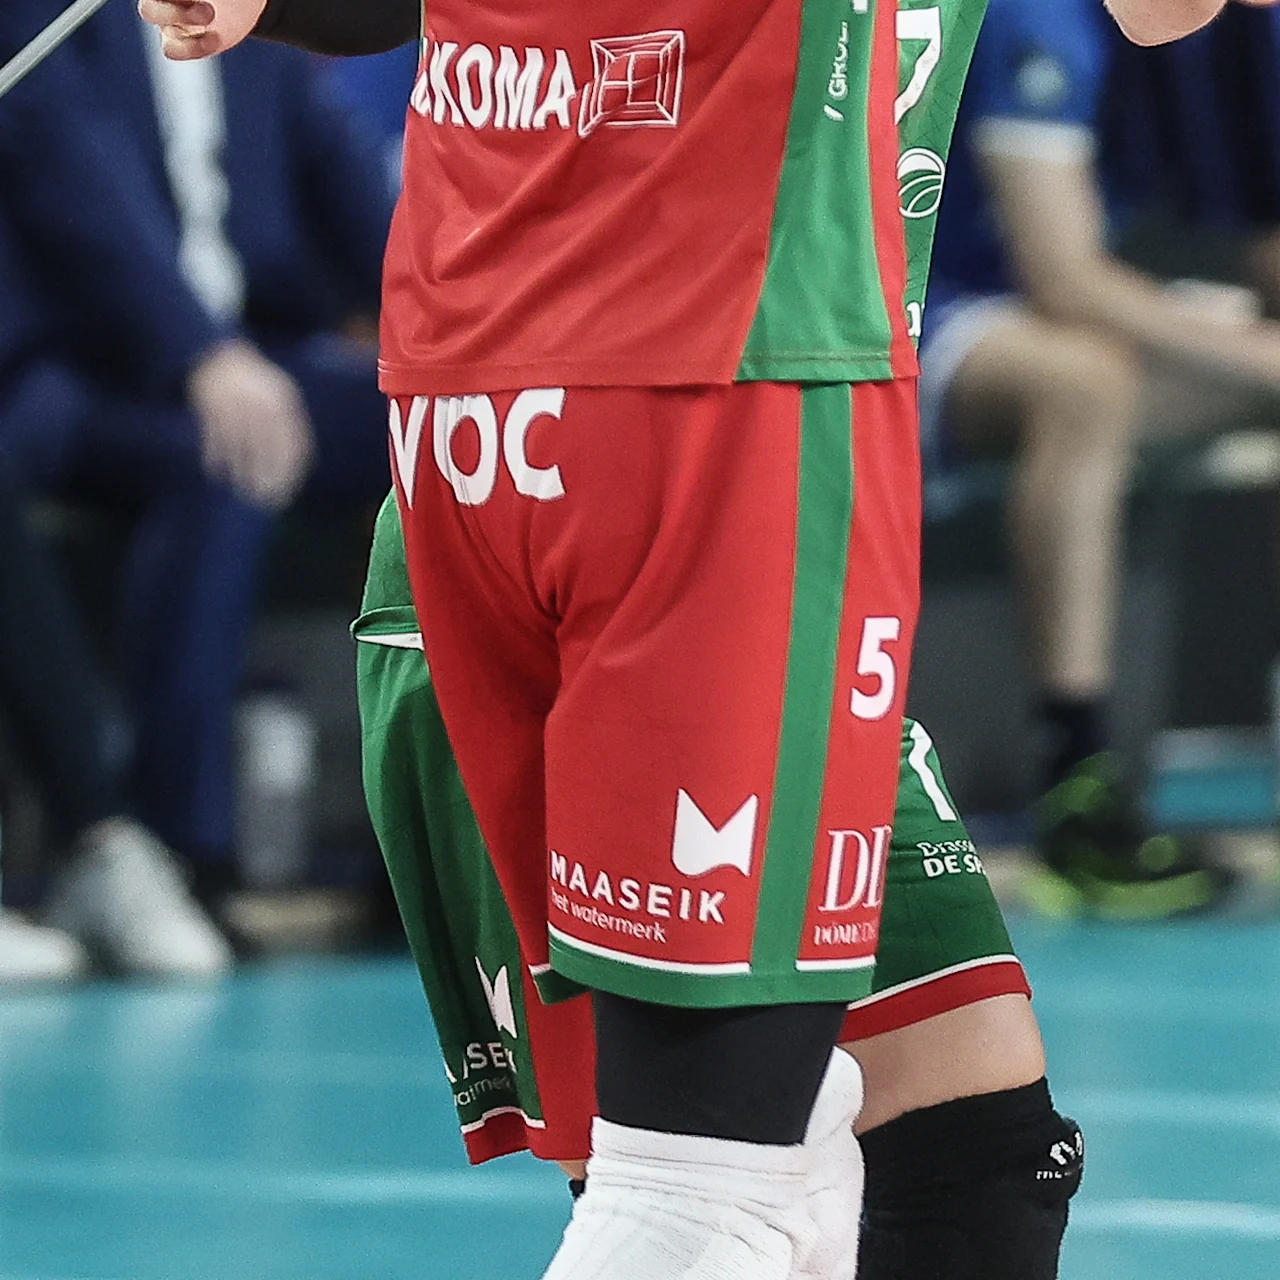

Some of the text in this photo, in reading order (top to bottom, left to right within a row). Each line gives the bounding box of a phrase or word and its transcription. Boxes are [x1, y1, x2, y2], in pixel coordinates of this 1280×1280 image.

[849, 616, 900, 720] 5
[551, 850, 725, 925] MAASEIK
[923, 857, 962, 878] DE
[570, 900, 667, 944] watermerk
